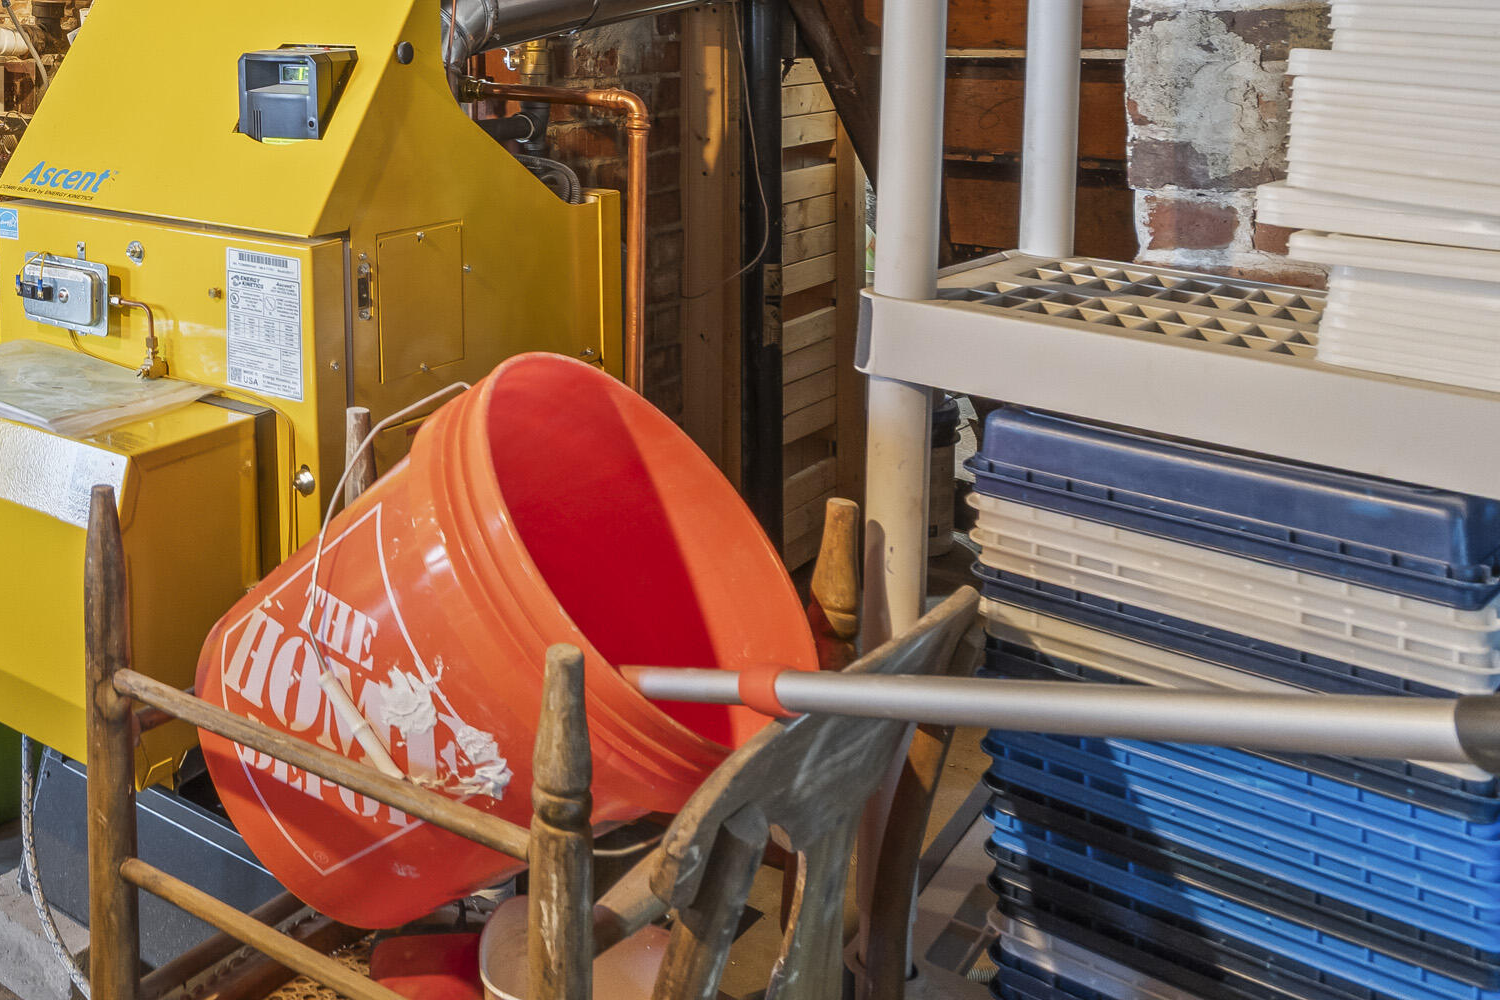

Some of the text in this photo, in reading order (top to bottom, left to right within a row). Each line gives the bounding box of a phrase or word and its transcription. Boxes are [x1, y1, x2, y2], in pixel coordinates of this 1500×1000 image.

[20, 160, 111, 193] Ascent
[0, 183, 19, 191] COMBI
[18, 186, 38, 194] BOILER
[67, 192, 95, 201] KINETICS
[240, 275, 261, 284] ENERGY
[242, 281, 264, 289] KINETICS
[243, 375, 259, 386] USA
[298, 581, 378, 672] THE
